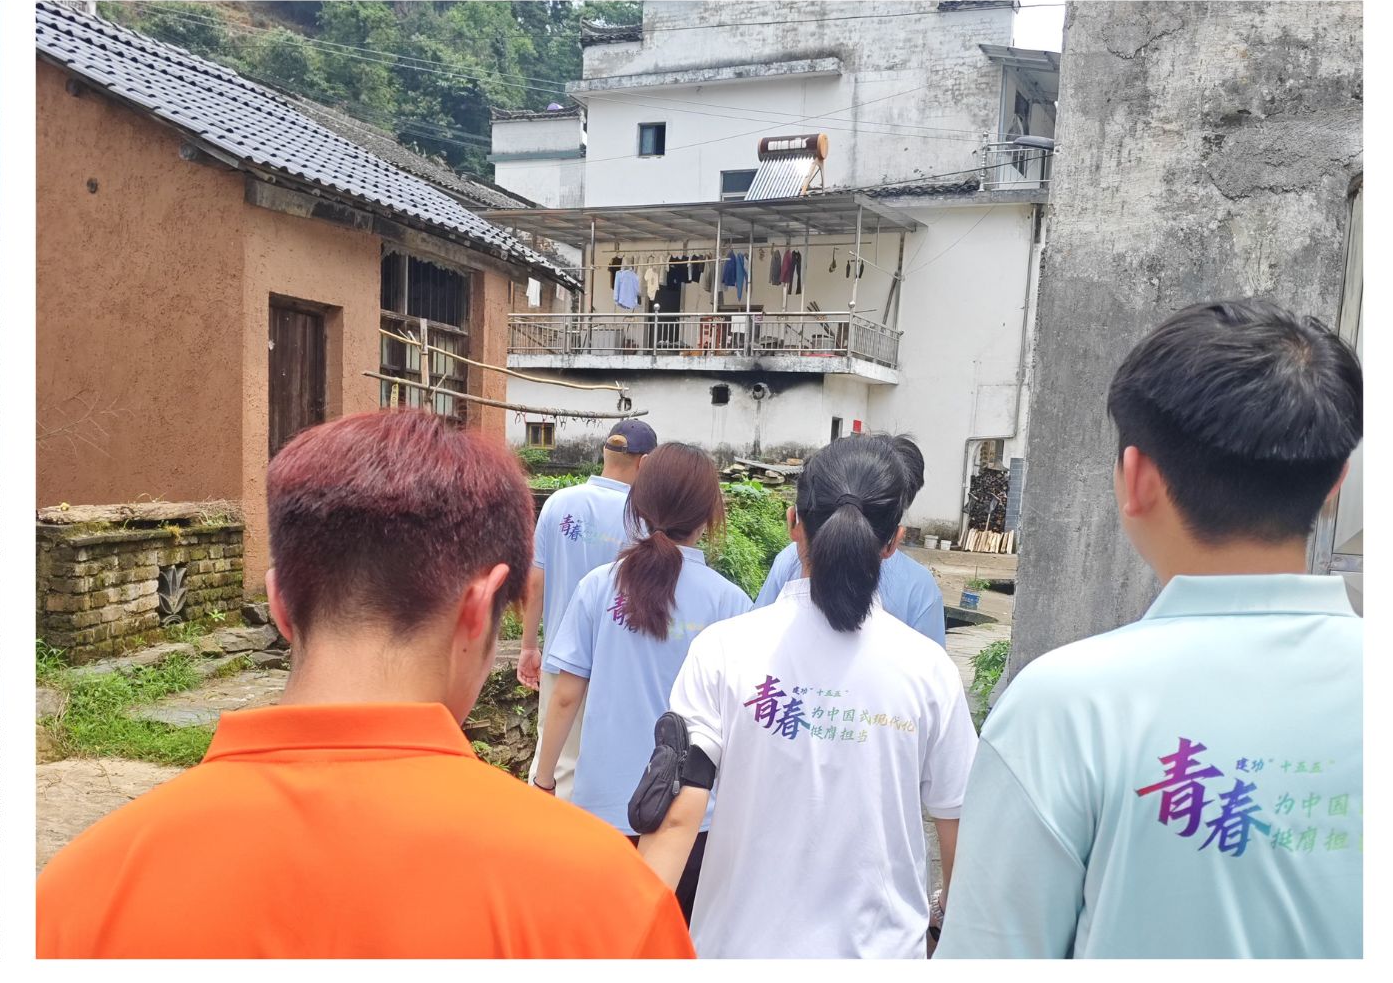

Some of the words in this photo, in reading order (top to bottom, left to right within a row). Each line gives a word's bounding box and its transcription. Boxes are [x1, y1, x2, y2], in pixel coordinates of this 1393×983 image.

[743, 674, 811, 740] 青春
[811, 706, 915, 733] 为中国式现代化
[1134, 736, 1272, 858] 青春
[1274, 791, 1363, 819] 为中国
[1270, 825, 1363, 855] 挺膺担
